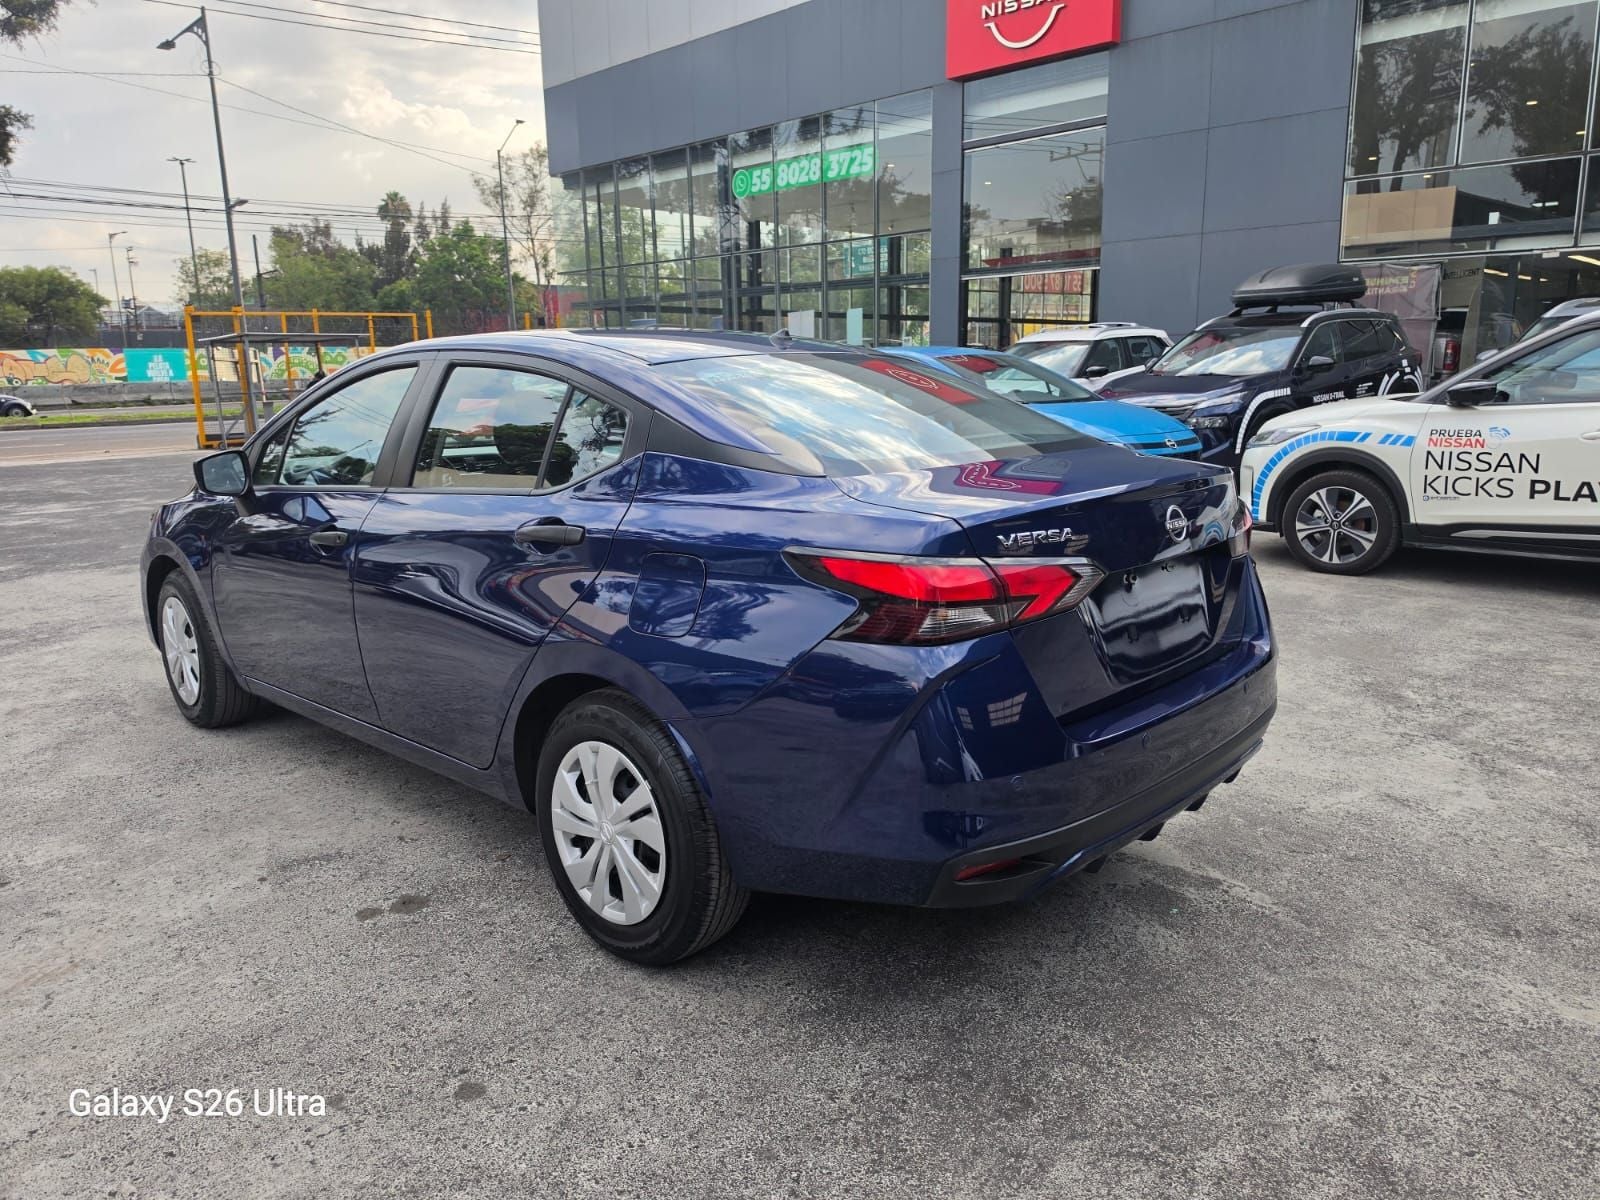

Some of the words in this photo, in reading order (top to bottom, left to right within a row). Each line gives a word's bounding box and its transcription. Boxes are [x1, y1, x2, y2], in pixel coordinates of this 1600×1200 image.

[981, 0, 1052, 19] NISS
[751, 168, 771, 193] 55
[777, 158, 821, 187] 8028
[827, 147, 874, 178] 3725
[1427, 437, 1486, 449] NISSAN
[1430, 429, 1482, 438] PRUEBA
[1425, 450, 1541, 475] NISSAN
[1423, 474, 1514, 499] KICKS
[1529, 479, 1600, 503] PLA
[1167, 520, 1187, 530] NISSA
[996, 528, 1073, 549] VERSA
